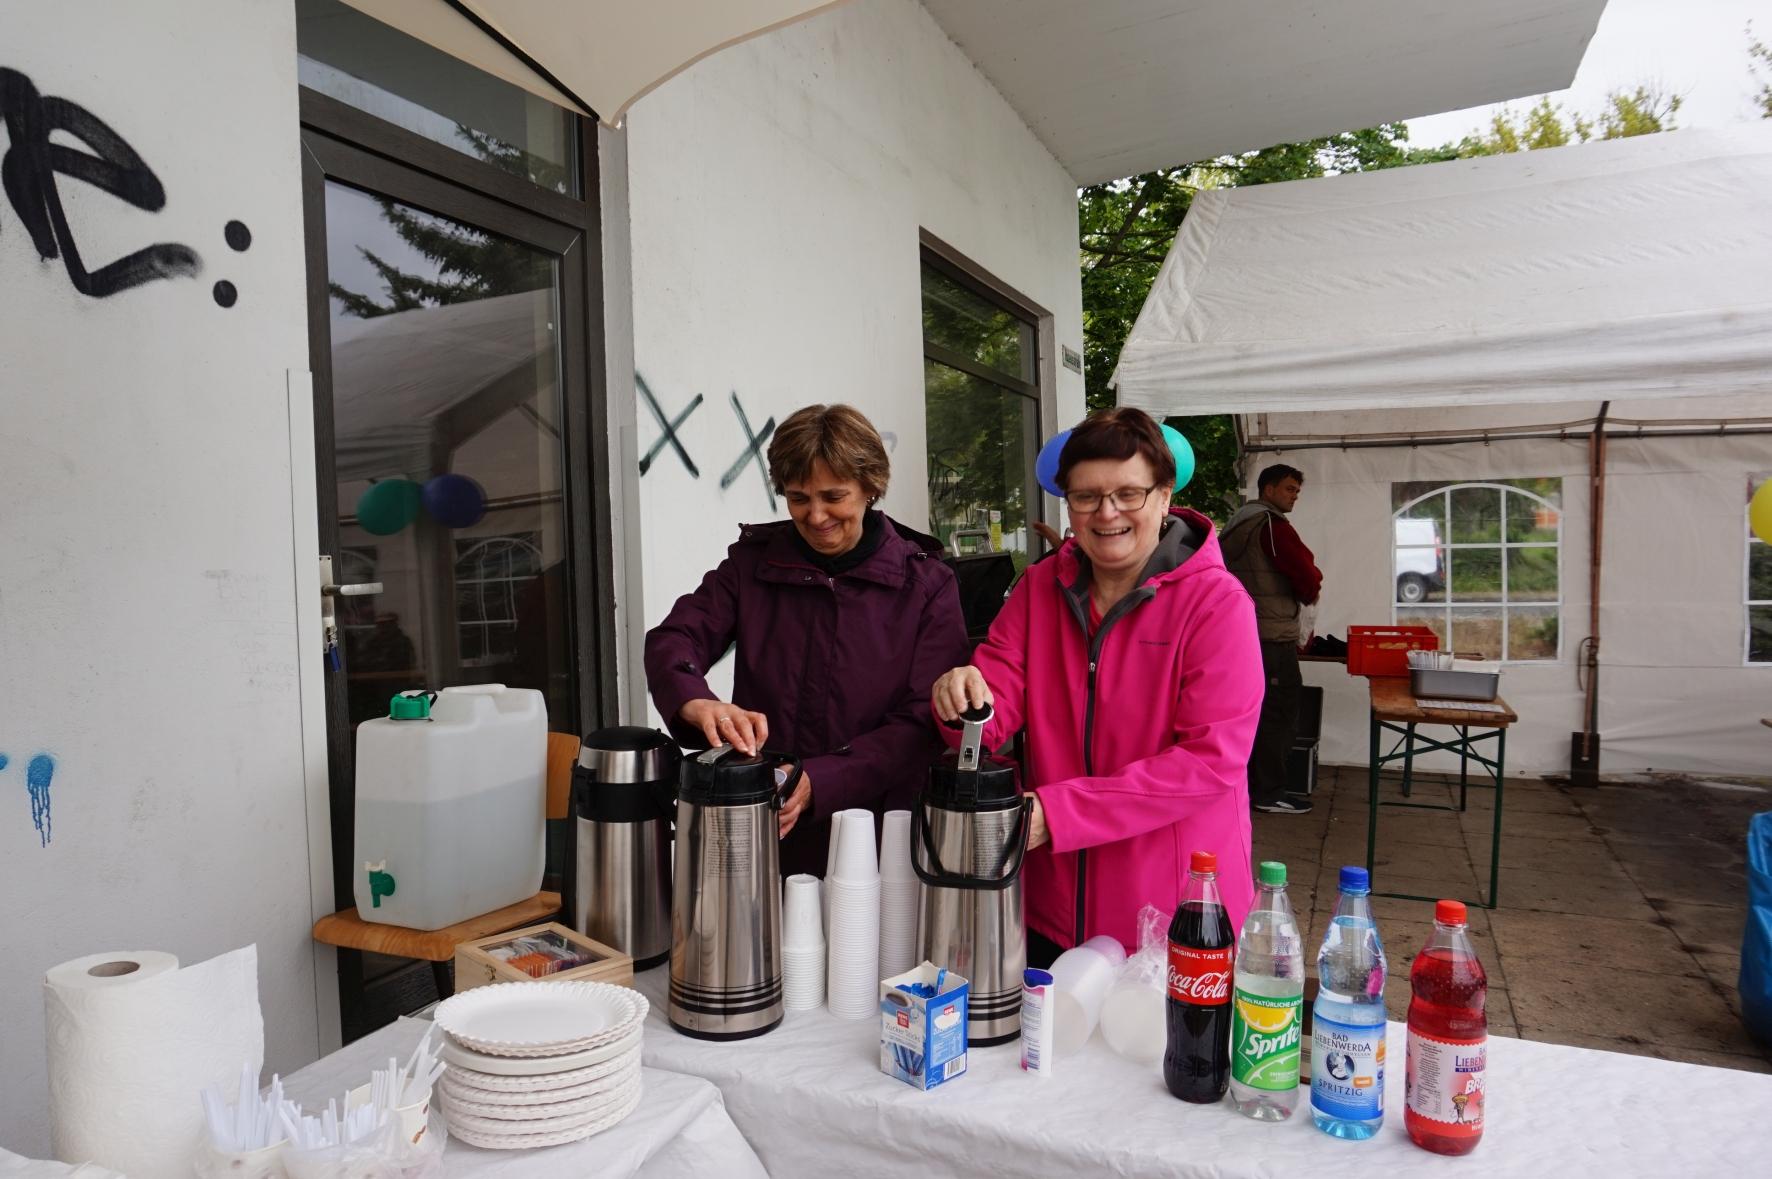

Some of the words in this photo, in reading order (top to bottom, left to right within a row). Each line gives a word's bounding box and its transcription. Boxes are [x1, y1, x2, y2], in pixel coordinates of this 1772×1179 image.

[1171, 946, 1201, 959] ORIGINAL
[1245, 1022, 1300, 1060] Sprite
[1314, 1029, 1372, 1052] LIEBENWERDA
[1332, 1032, 1349, 1042] BAD
[1318, 1079, 1363, 1097] SPRITZIG
